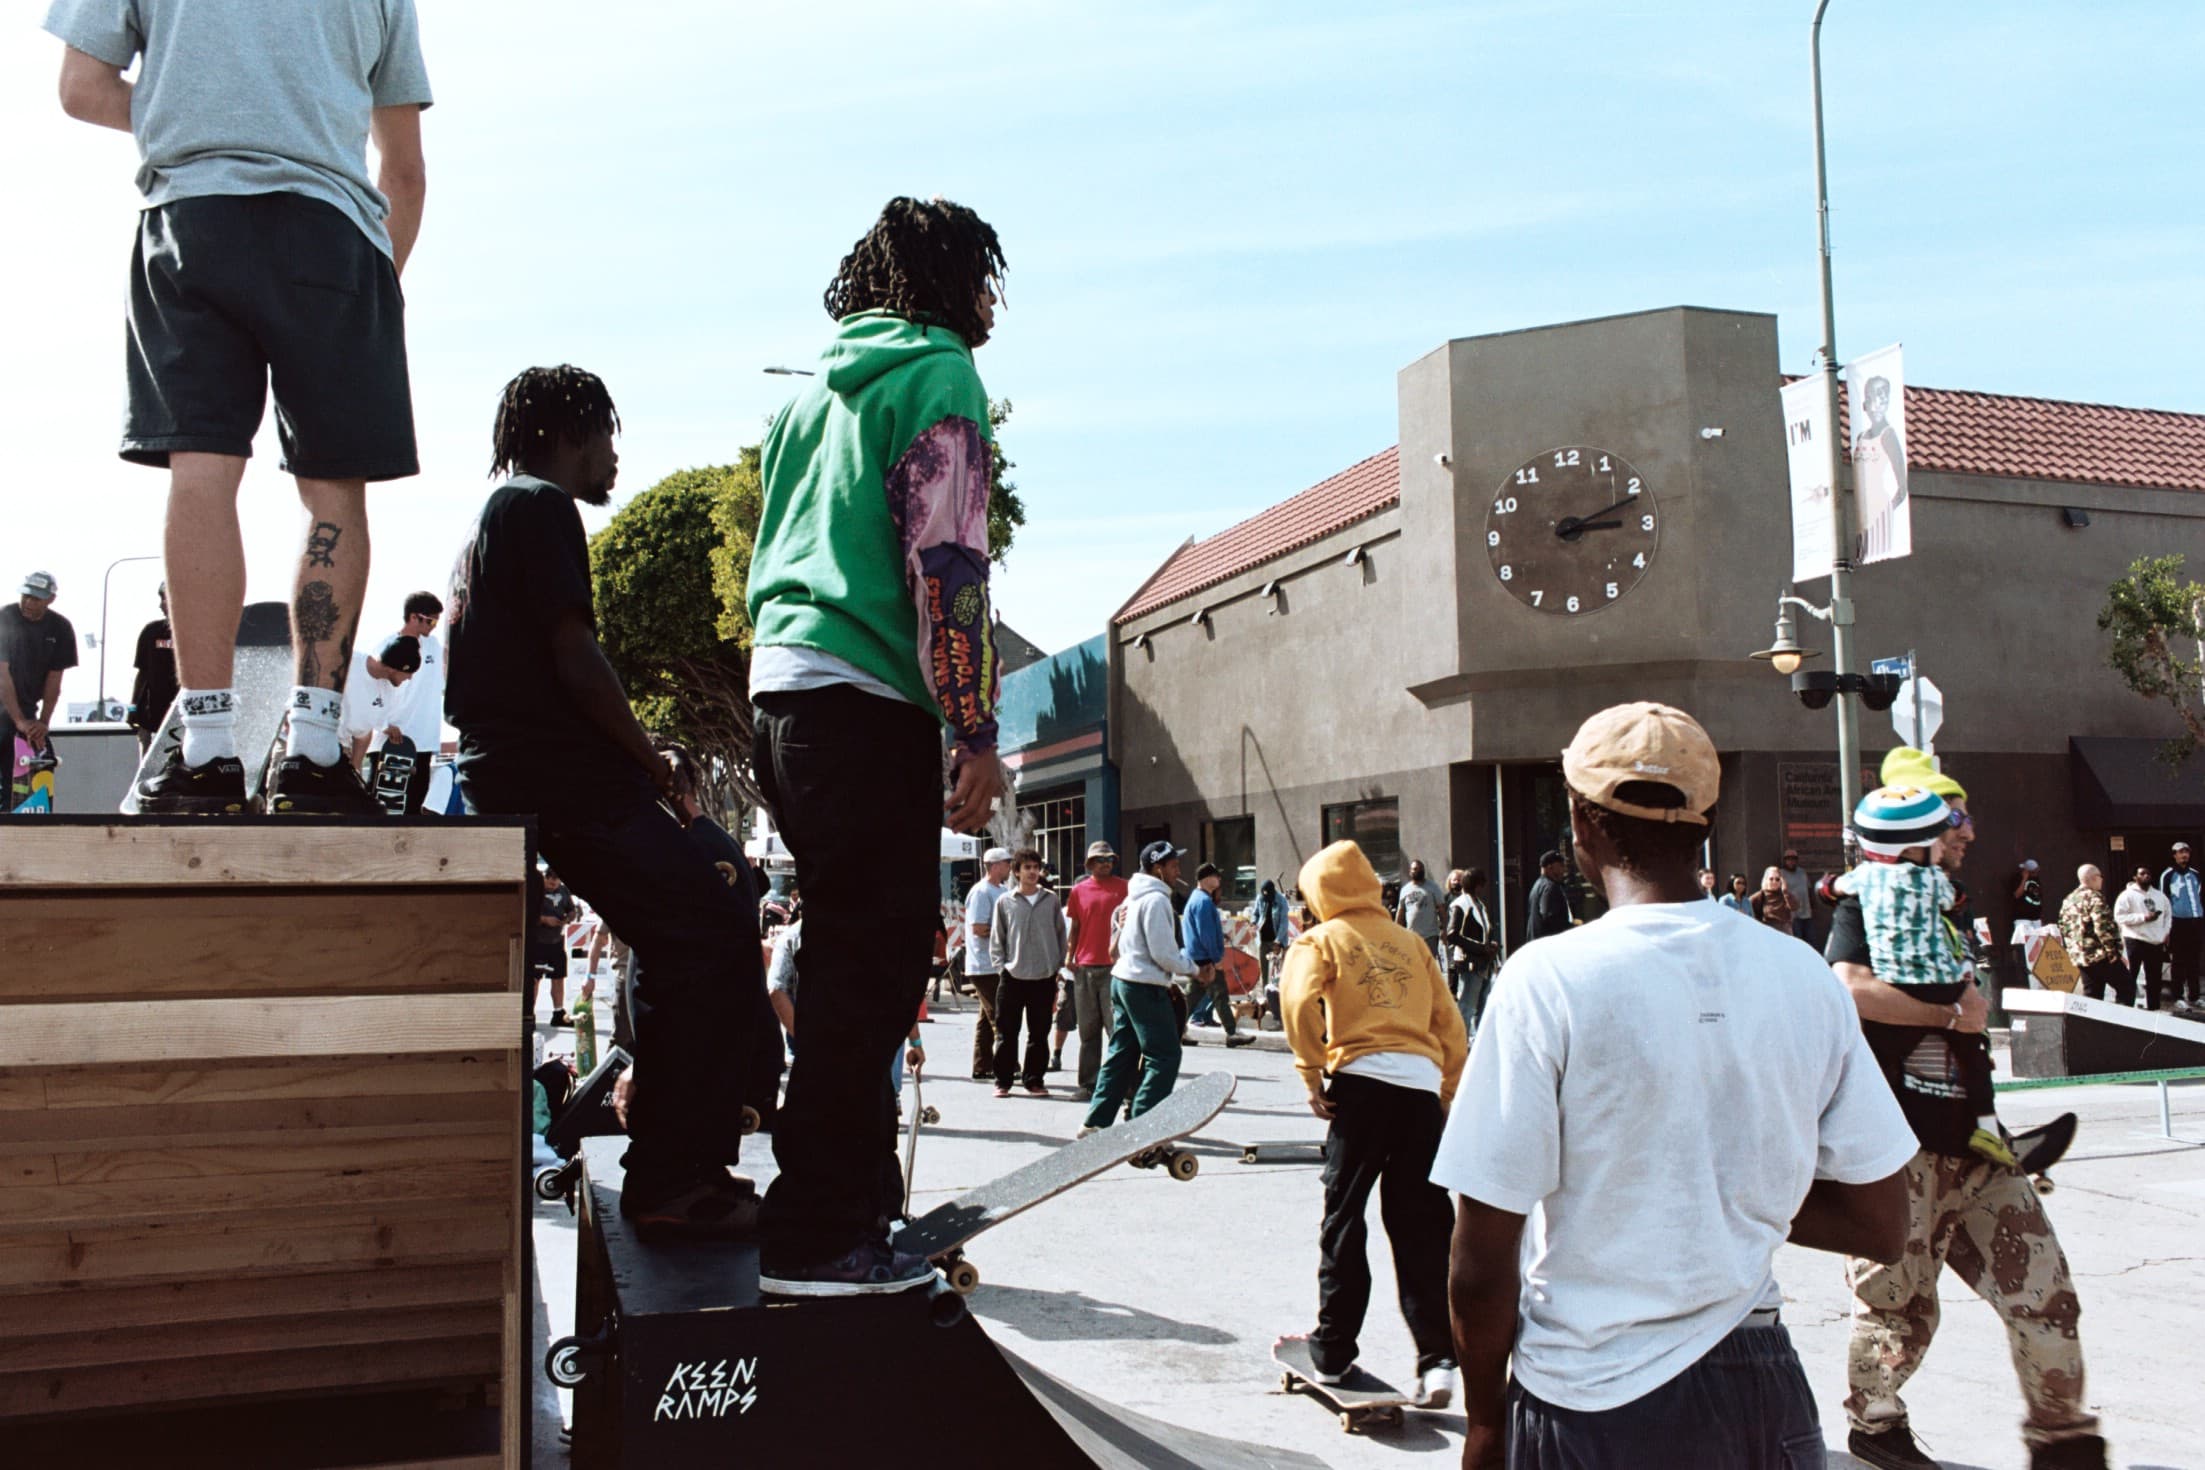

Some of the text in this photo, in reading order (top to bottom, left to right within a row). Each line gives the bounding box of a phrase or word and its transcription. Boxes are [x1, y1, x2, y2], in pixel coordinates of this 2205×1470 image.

[1790, 418, 1812, 447] I'M
[1554, 449, 1580, 467] 12
[1600, 456, 1611, 472] 1
[1516, 467, 1540, 484] 11
[1628, 478, 1641, 494] 2
[1495, 497, 1518, 514] 10
[1641, 515, 1654, 531] 3
[1488, 531, 1500, 546] 9
[1633, 552, 1646, 568] 4
[1500, 565, 1513, 580] 8
[1530, 590, 1543, 606] 7
[1606, 582, 1619, 598] 5
[1567, 596, 1579, 612] 6
[932, 626, 950, 687] SMALL
[948, 628, 977, 735] LIKE YOURS
[665, 1356, 758, 1392] KEEN
[654, 1386, 758, 1422] RAMPS
